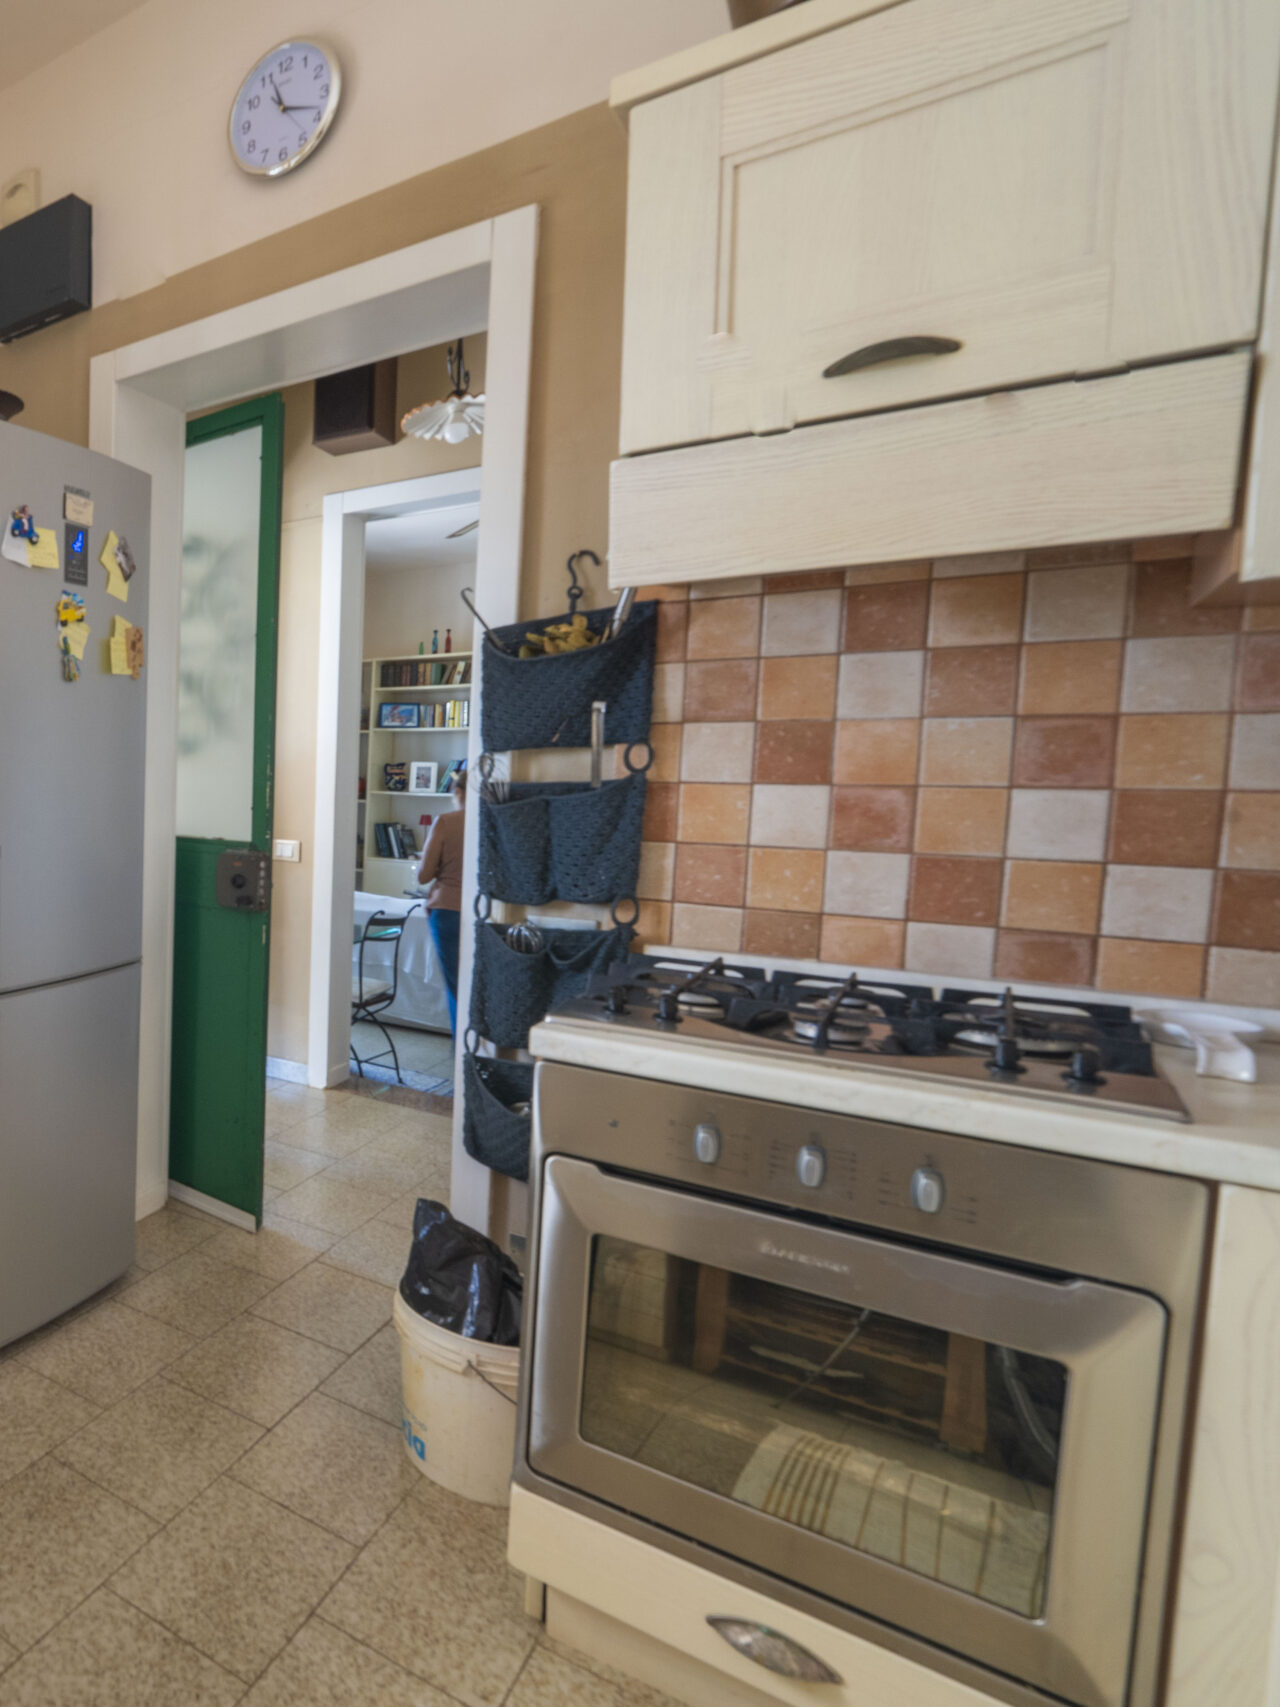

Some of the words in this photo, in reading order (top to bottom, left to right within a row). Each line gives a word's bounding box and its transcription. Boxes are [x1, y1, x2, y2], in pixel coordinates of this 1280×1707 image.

[278, 56, 294, 74] 12
[302, 55, 309, 69] 1
[260, 71, 274, 88] 11
[313, 64, 324, 80] 2
[320, 83, 330, 99] 3
[247, 95, 261, 111] 10
[312, 110, 322, 123] 4
[241, 120, 251, 135] 9
[247, 139, 256, 154] 8
[297, 131, 308, 148] 5
[260, 148, 269, 163] 7
[278, 146, 288, 161] 6
